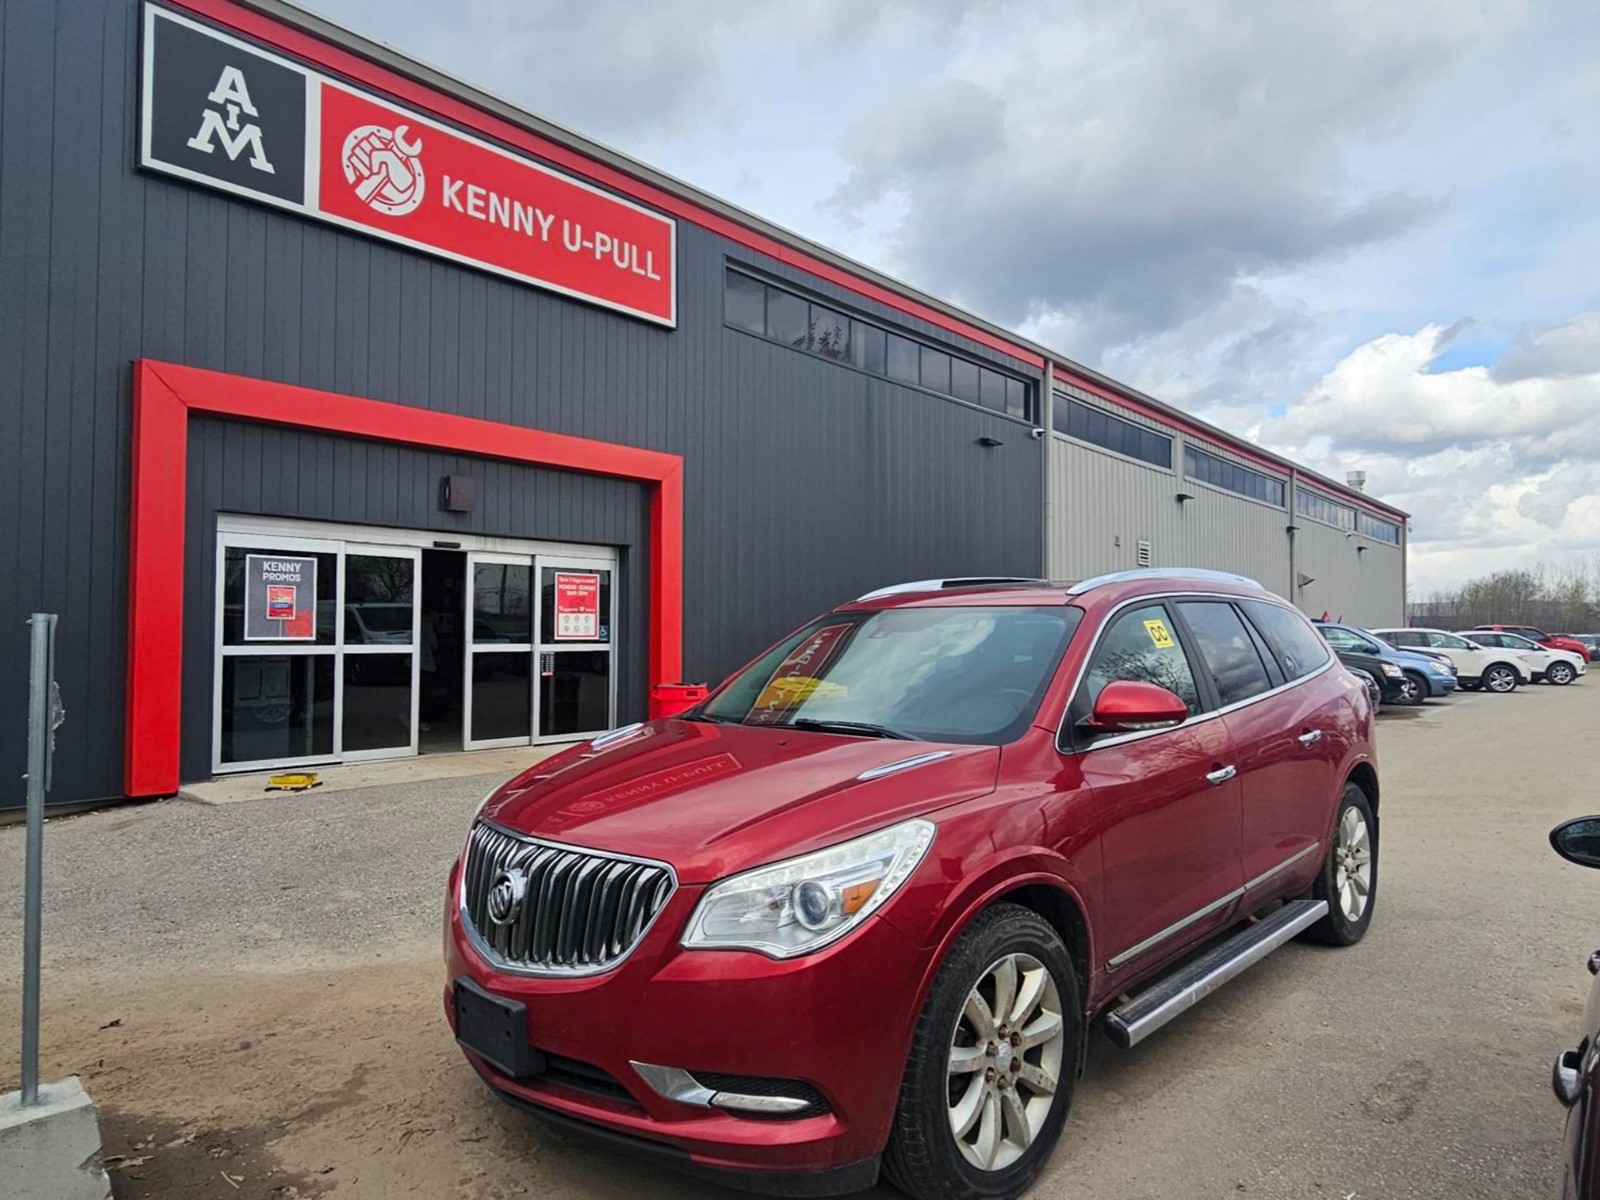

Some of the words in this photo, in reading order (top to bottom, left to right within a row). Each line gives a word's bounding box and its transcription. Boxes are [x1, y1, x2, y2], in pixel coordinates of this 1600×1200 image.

[441, 174, 556, 242] KENNY
[562, 222, 662, 281] U-PULL
[262, 561, 302, 573] KENNY
[262, 572, 302, 582] PROMOS
[1150, 625, 1169, 642] CC
